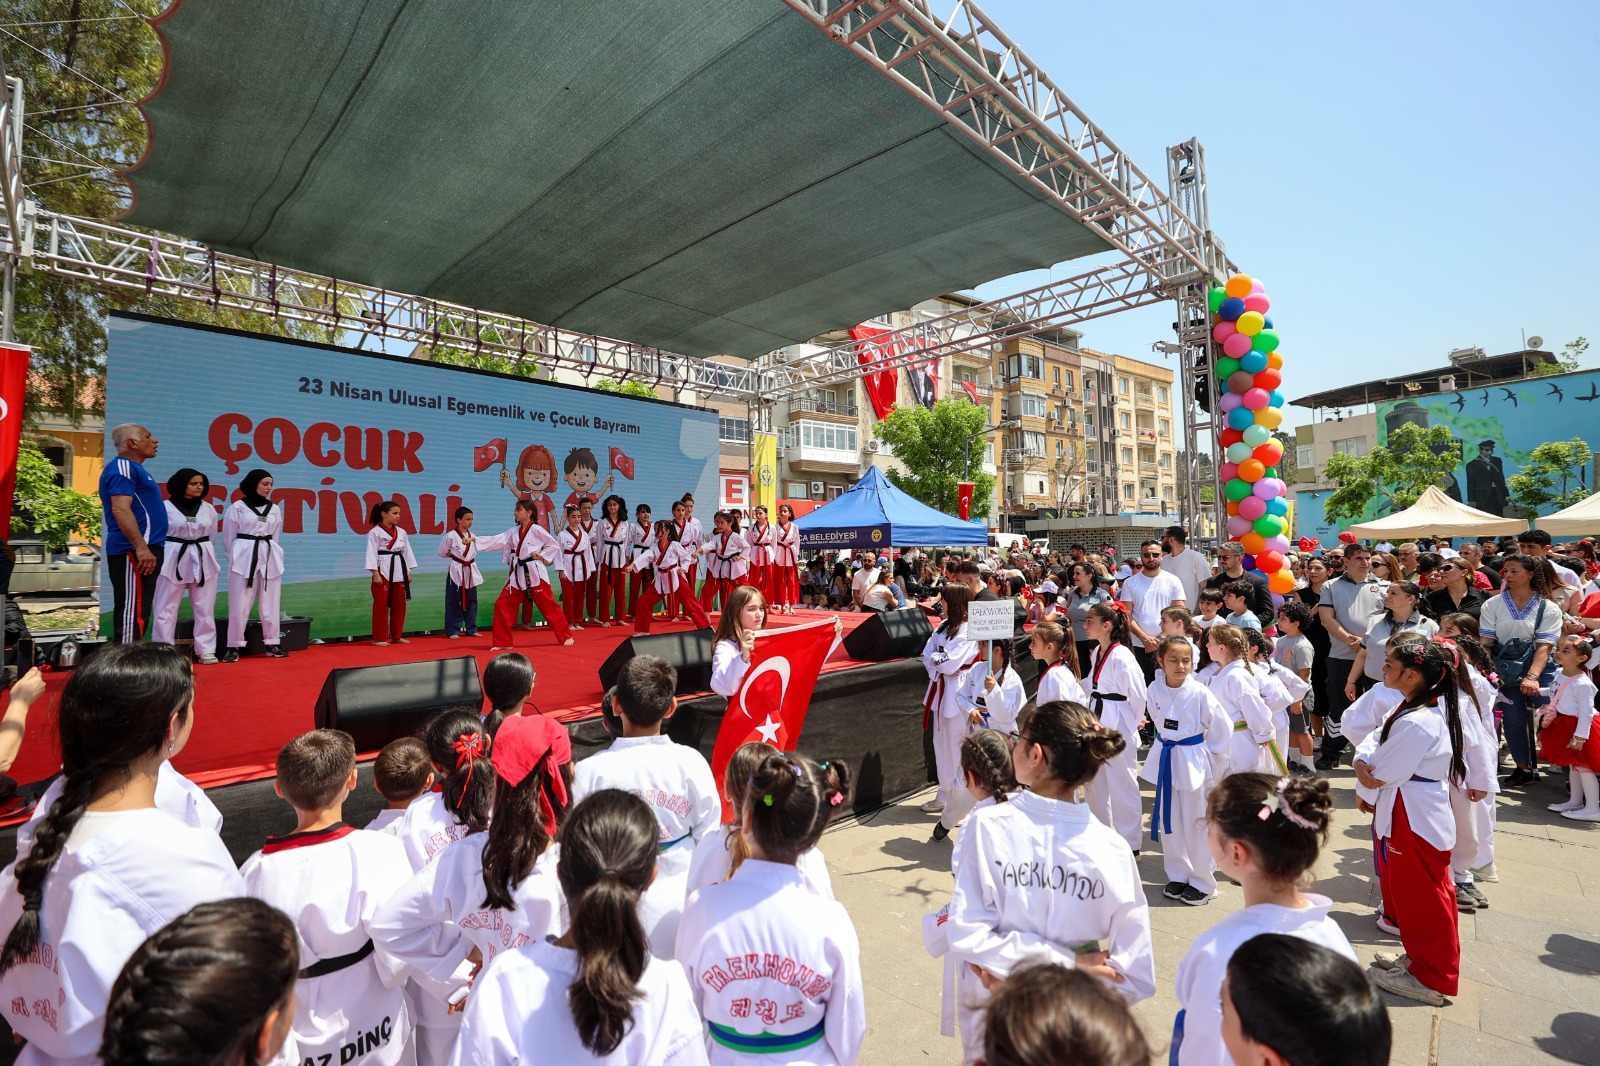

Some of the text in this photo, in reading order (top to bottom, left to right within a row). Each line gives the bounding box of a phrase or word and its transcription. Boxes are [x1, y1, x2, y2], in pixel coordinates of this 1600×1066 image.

[298, 377, 641, 434] 23 Nisan Ulusal Egemenlik ve Çocuk Bayramı
[208, 412, 425, 475] ÇOCUK
[158, 476, 463, 535] ETİVALİ
[725, 478, 744, 504] E
[810, 530, 858, 541] BELEDİYESİ
[971, 606, 1012, 616] TAEKWONDO
[340, 1015, 392, 1066] DİNÇ
